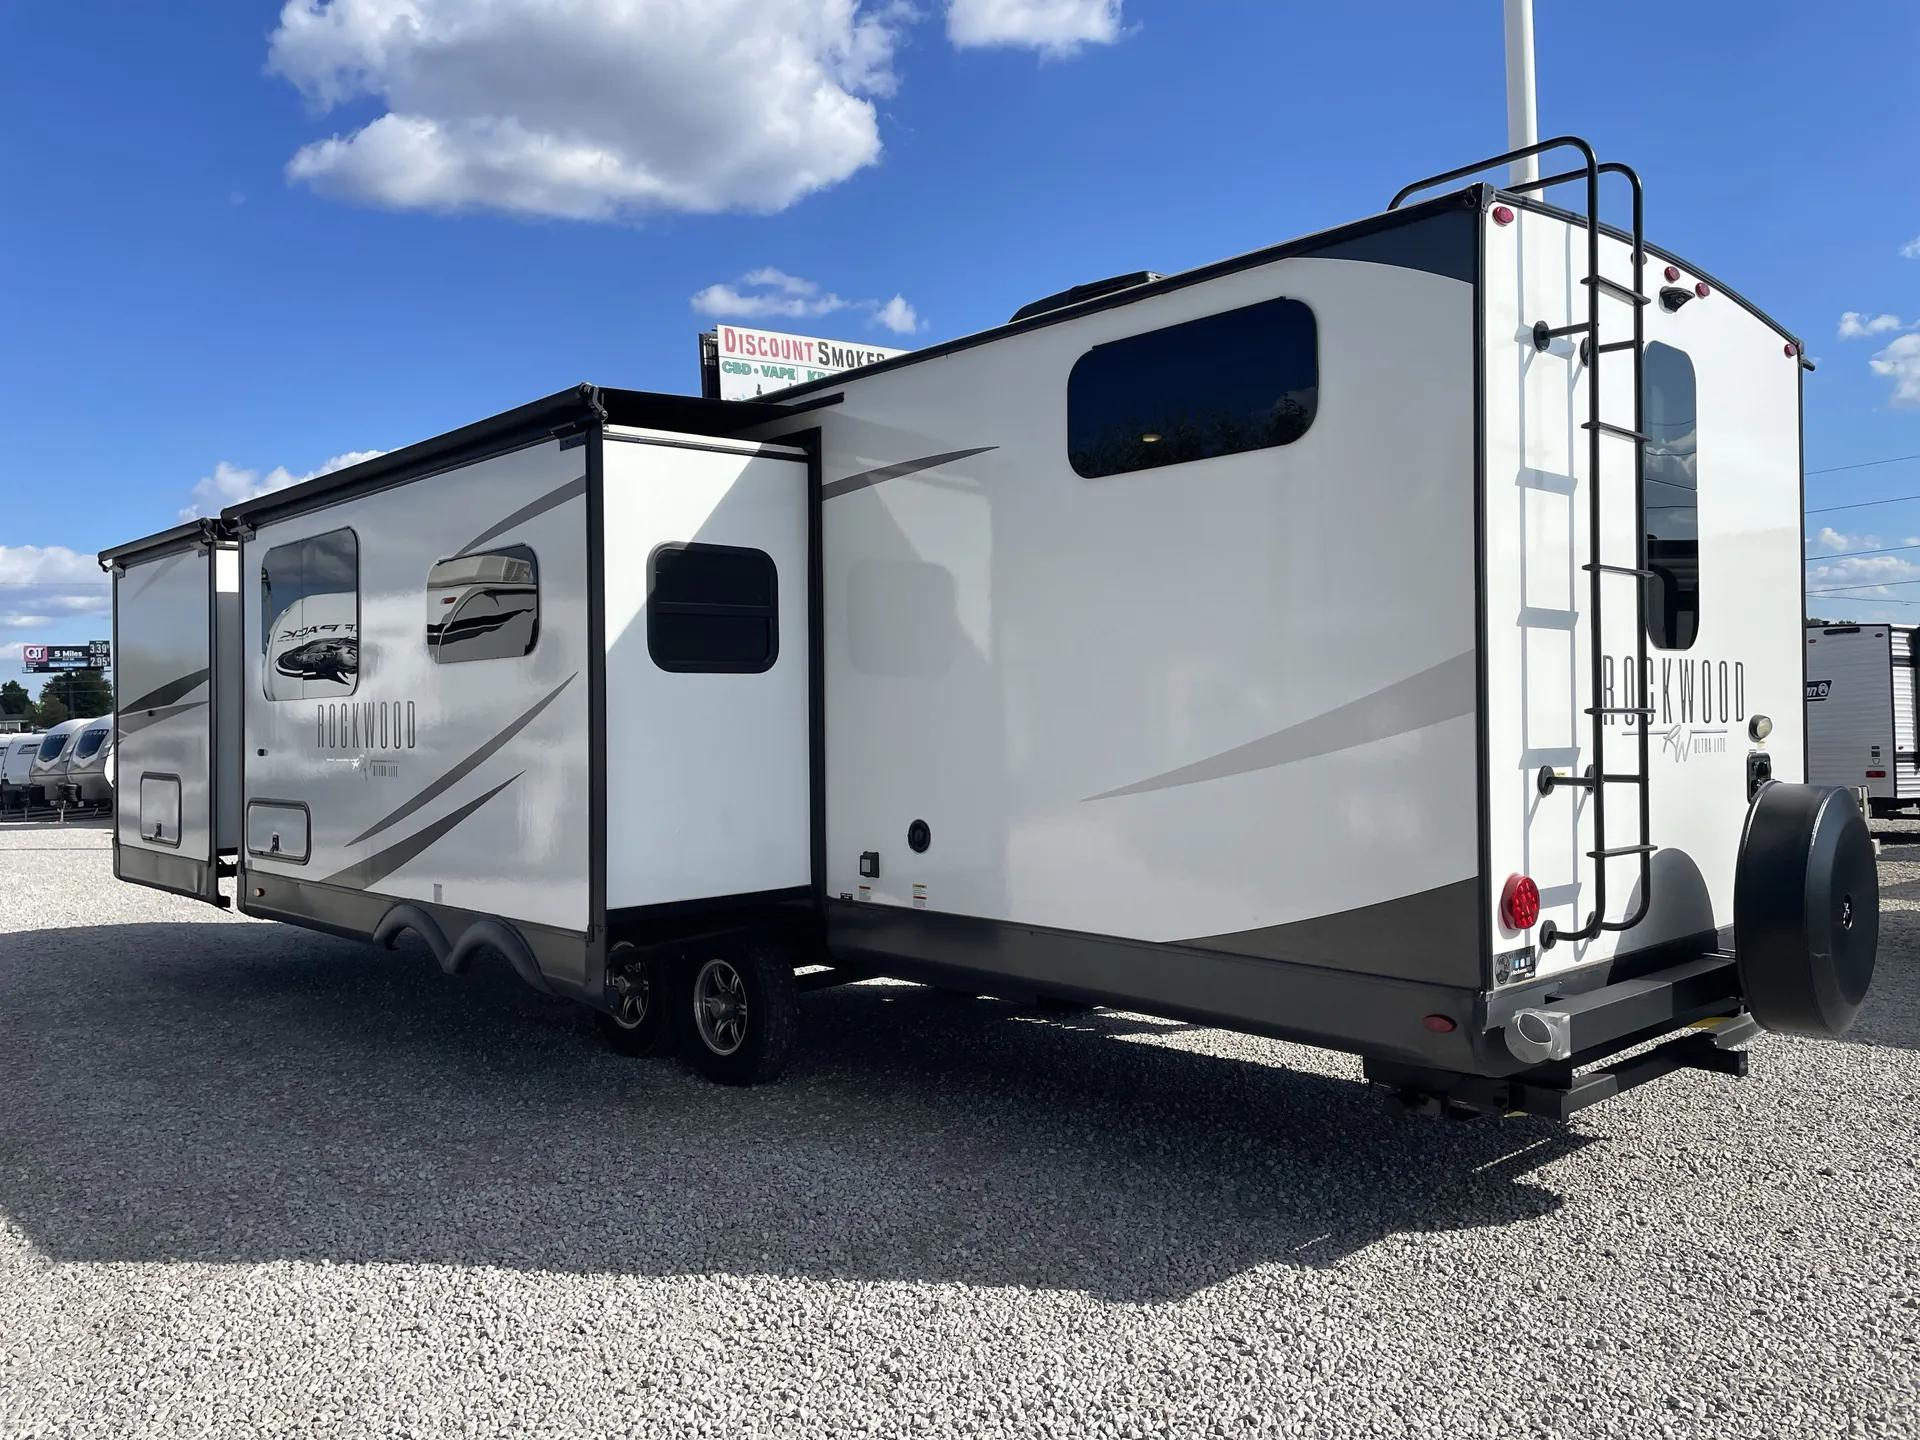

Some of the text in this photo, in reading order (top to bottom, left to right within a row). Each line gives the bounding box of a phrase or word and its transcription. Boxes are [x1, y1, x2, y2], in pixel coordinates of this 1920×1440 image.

[724, 327, 814, 363] DISCOUNT
[721, 360, 752, 376] CBD
[761, 364, 797, 381] VAPE
[26, 647, 44, 660] QT
[1602, 654, 1745, 726] ROCKWOOD
[317, 700, 416, 750] ROCKWOOD
[1694, 737, 1726, 754] ULTRA LITE
